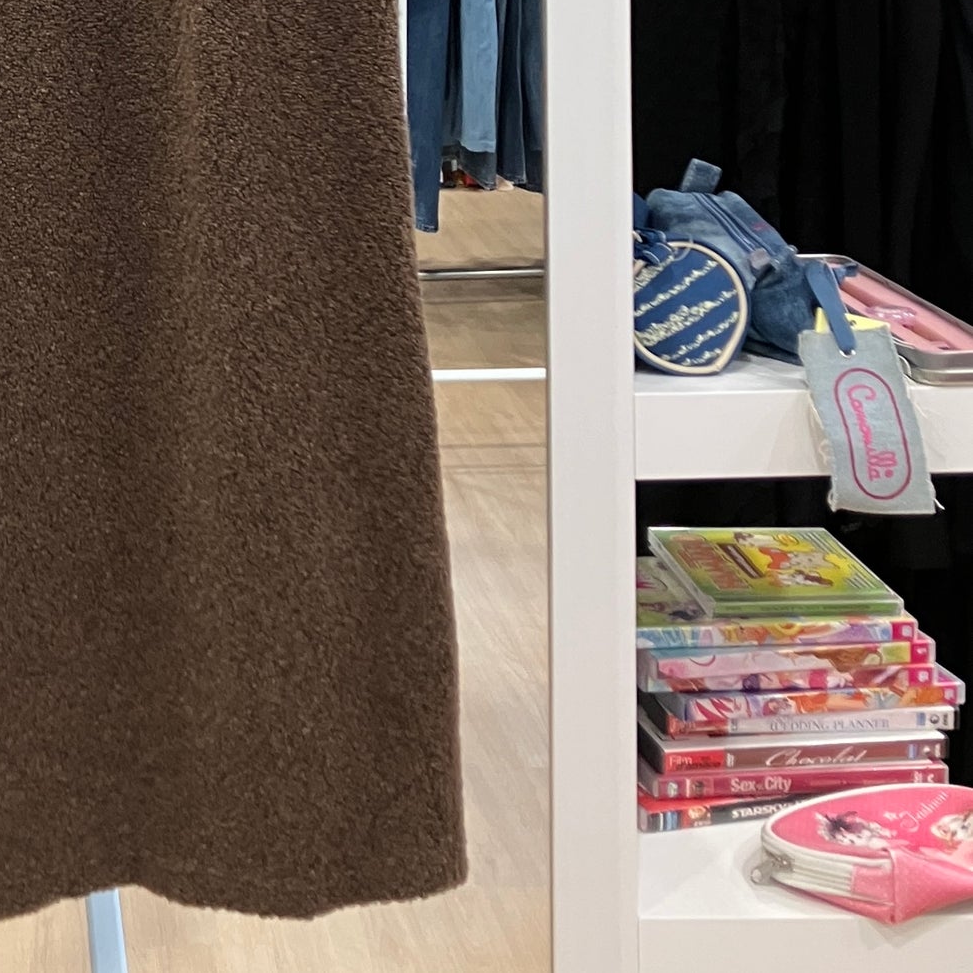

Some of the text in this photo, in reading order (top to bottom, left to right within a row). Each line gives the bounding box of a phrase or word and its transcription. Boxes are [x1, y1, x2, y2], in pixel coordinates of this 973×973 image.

[833, 718, 889, 731] PLANNER
[730, 776, 791, 792] Sex City
